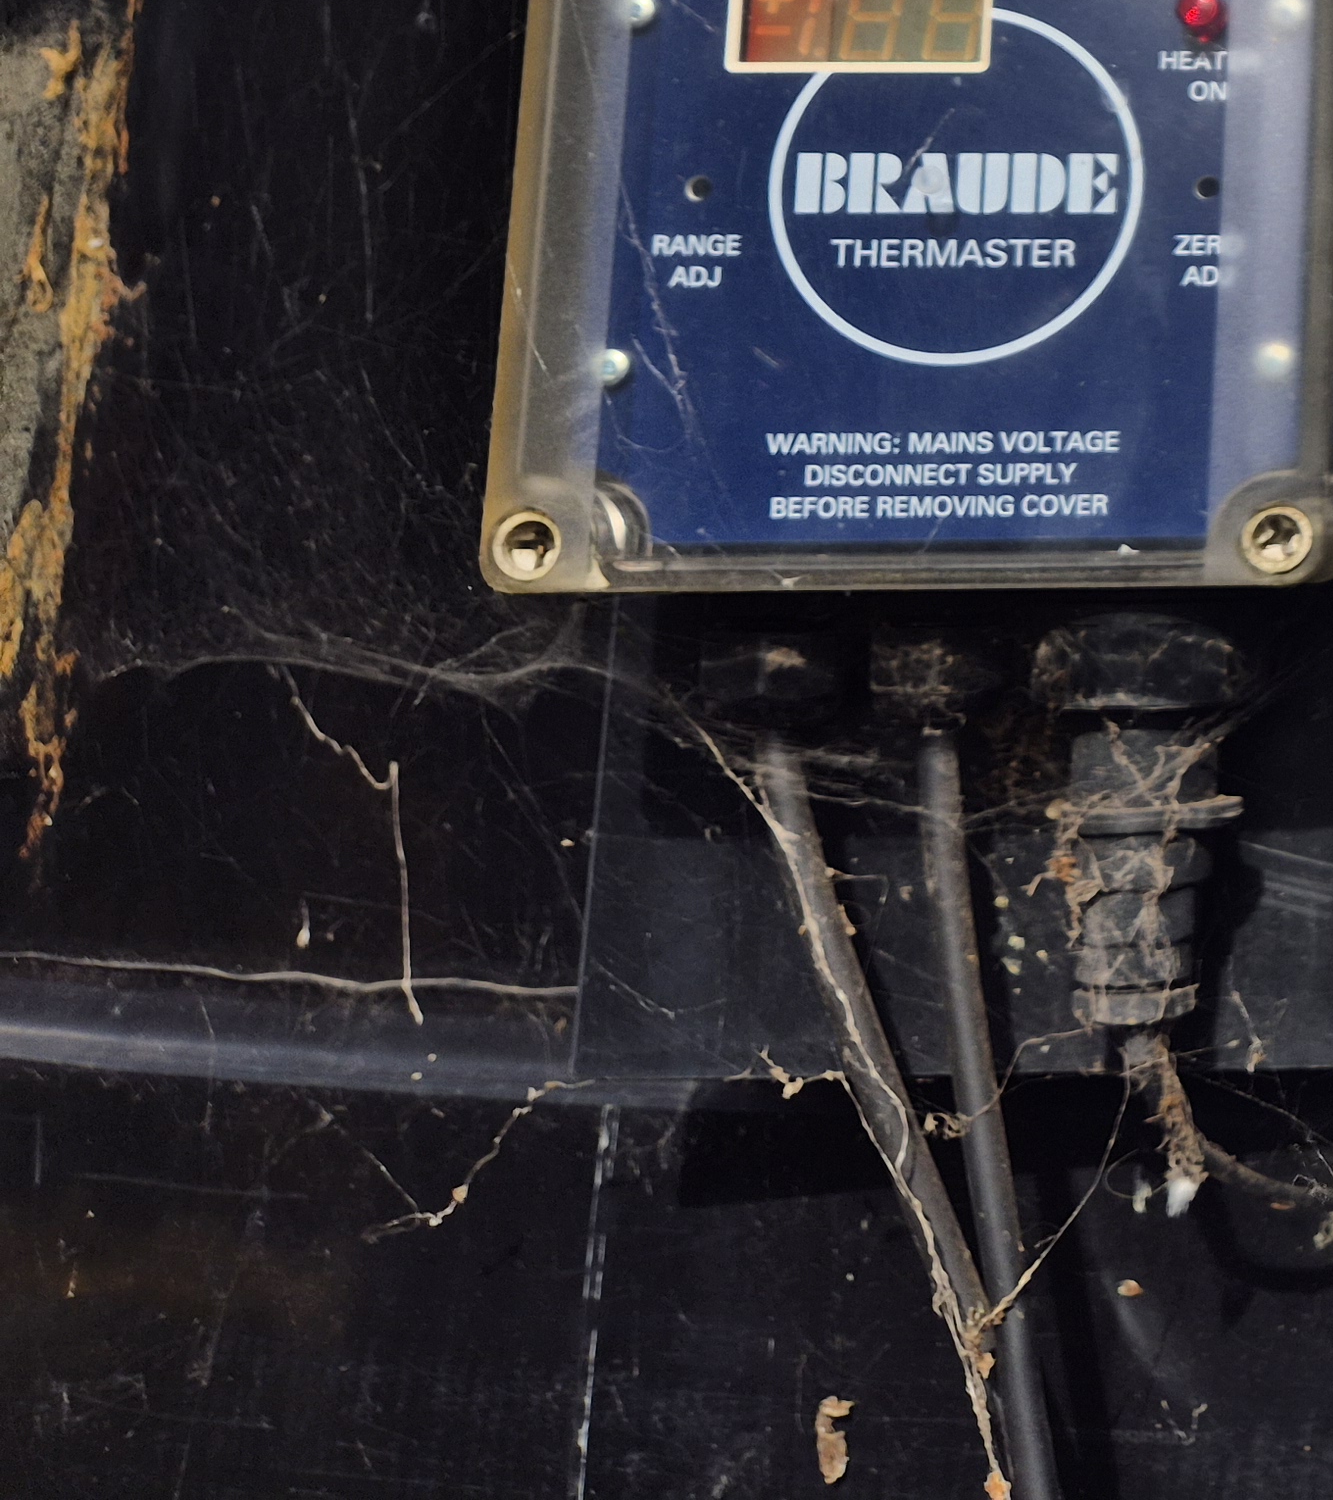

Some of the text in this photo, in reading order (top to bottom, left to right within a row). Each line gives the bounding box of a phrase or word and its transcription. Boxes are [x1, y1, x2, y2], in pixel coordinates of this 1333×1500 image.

[1187, 80, 1229, 102] ON
[793, 151, 1120, 215] BRAUDE
[651, 233, 744, 258] RANGE
[829, 237, 1077, 269] THERMASTER
[1171, 233, 1244, 257] ZER
[668, 265, 725, 289] ADJ
[1178, 265, 1234, 287] AD
[764, 430, 1122, 456] WARNING: MAINS VOLTAGE
[803, 462, 1078, 487] DISCONNECT SUPPLY
[769, 493, 1110, 520] BEFORE REMOVING COVER
